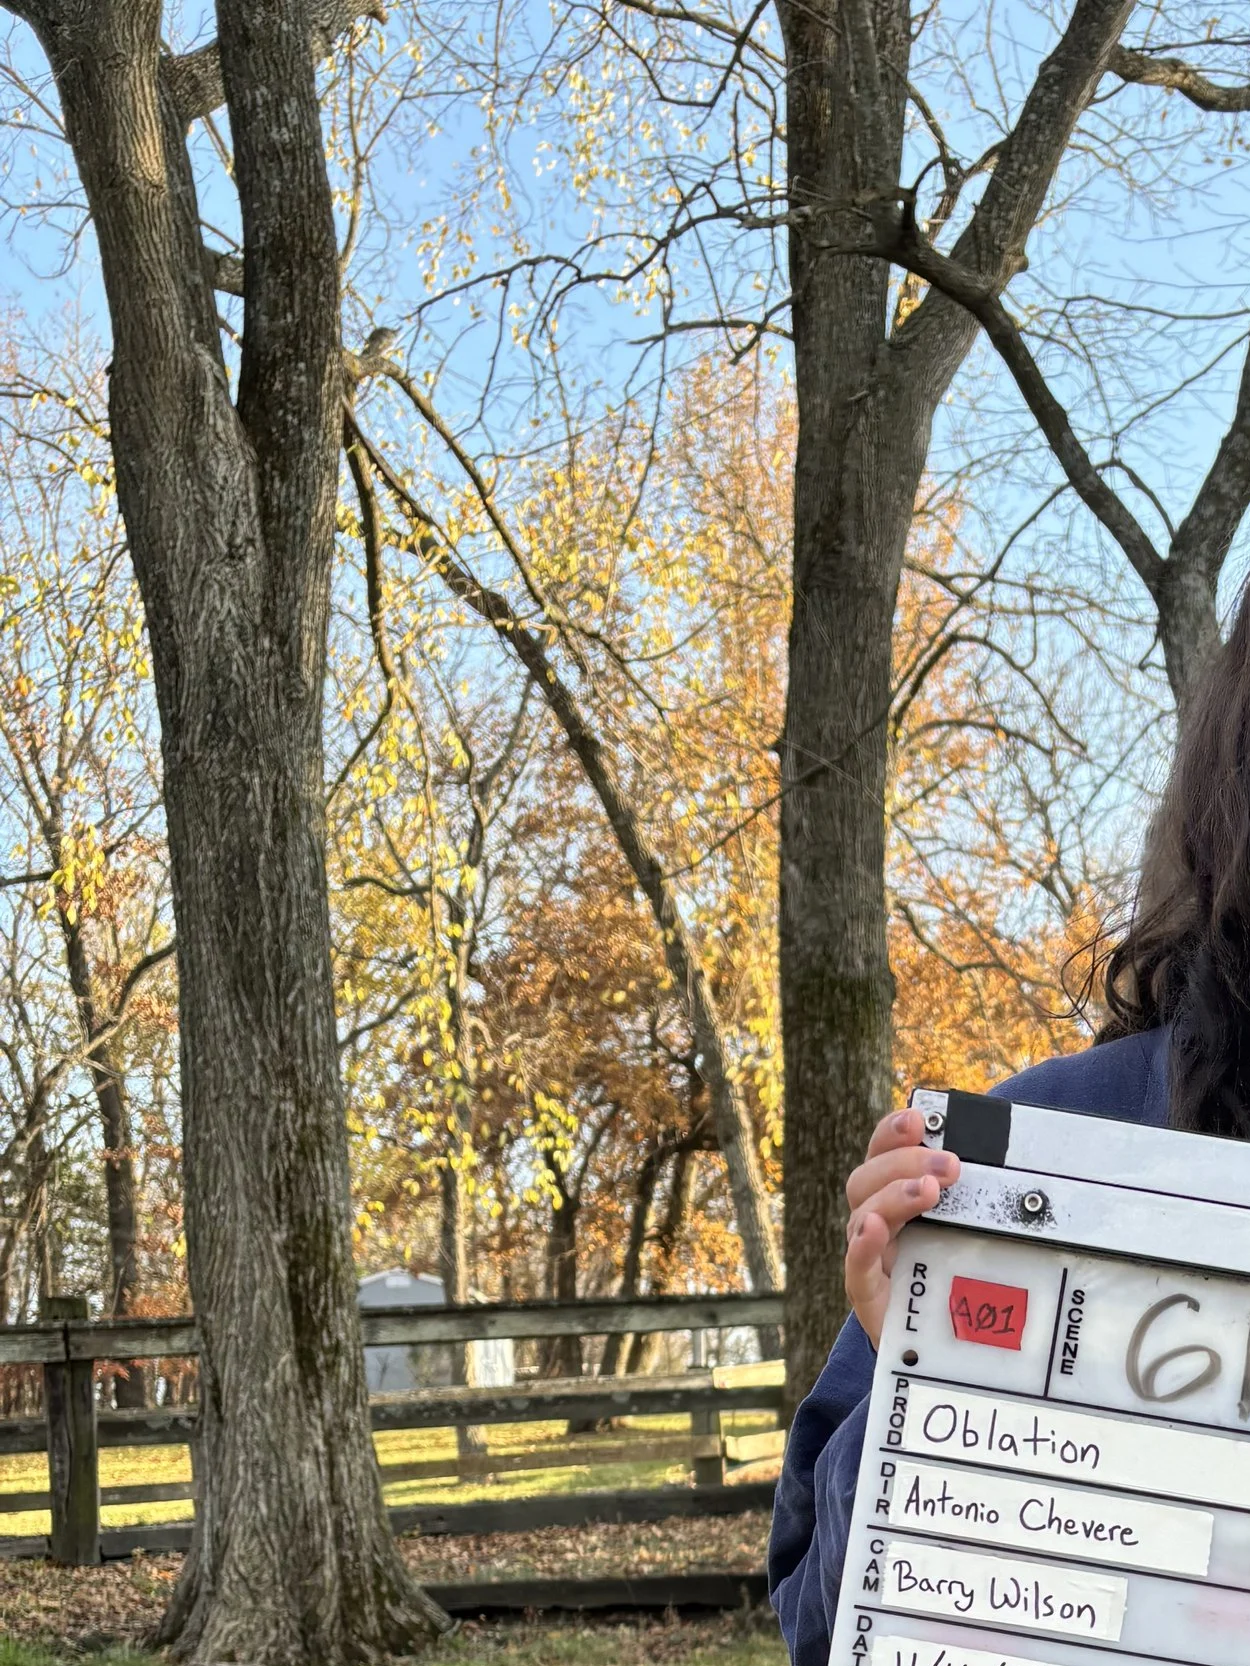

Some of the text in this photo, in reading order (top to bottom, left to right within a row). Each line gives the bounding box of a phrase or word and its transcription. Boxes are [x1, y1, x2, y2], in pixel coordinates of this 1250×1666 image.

[905, 1262, 928, 1332] ROLL
[1060, 1289, 1086, 1376] SCENE
[887, 1378, 909, 1447] PROD
[923, 1404, 1100, 1469] Oblation
[875, 1462, 896, 1516] DIR
[904, 1475, 1139, 1546] Antonio Chevere
[863, 1539, 885, 1593] CAM
[893, 1560, 1096, 1628] Barry Wilson
